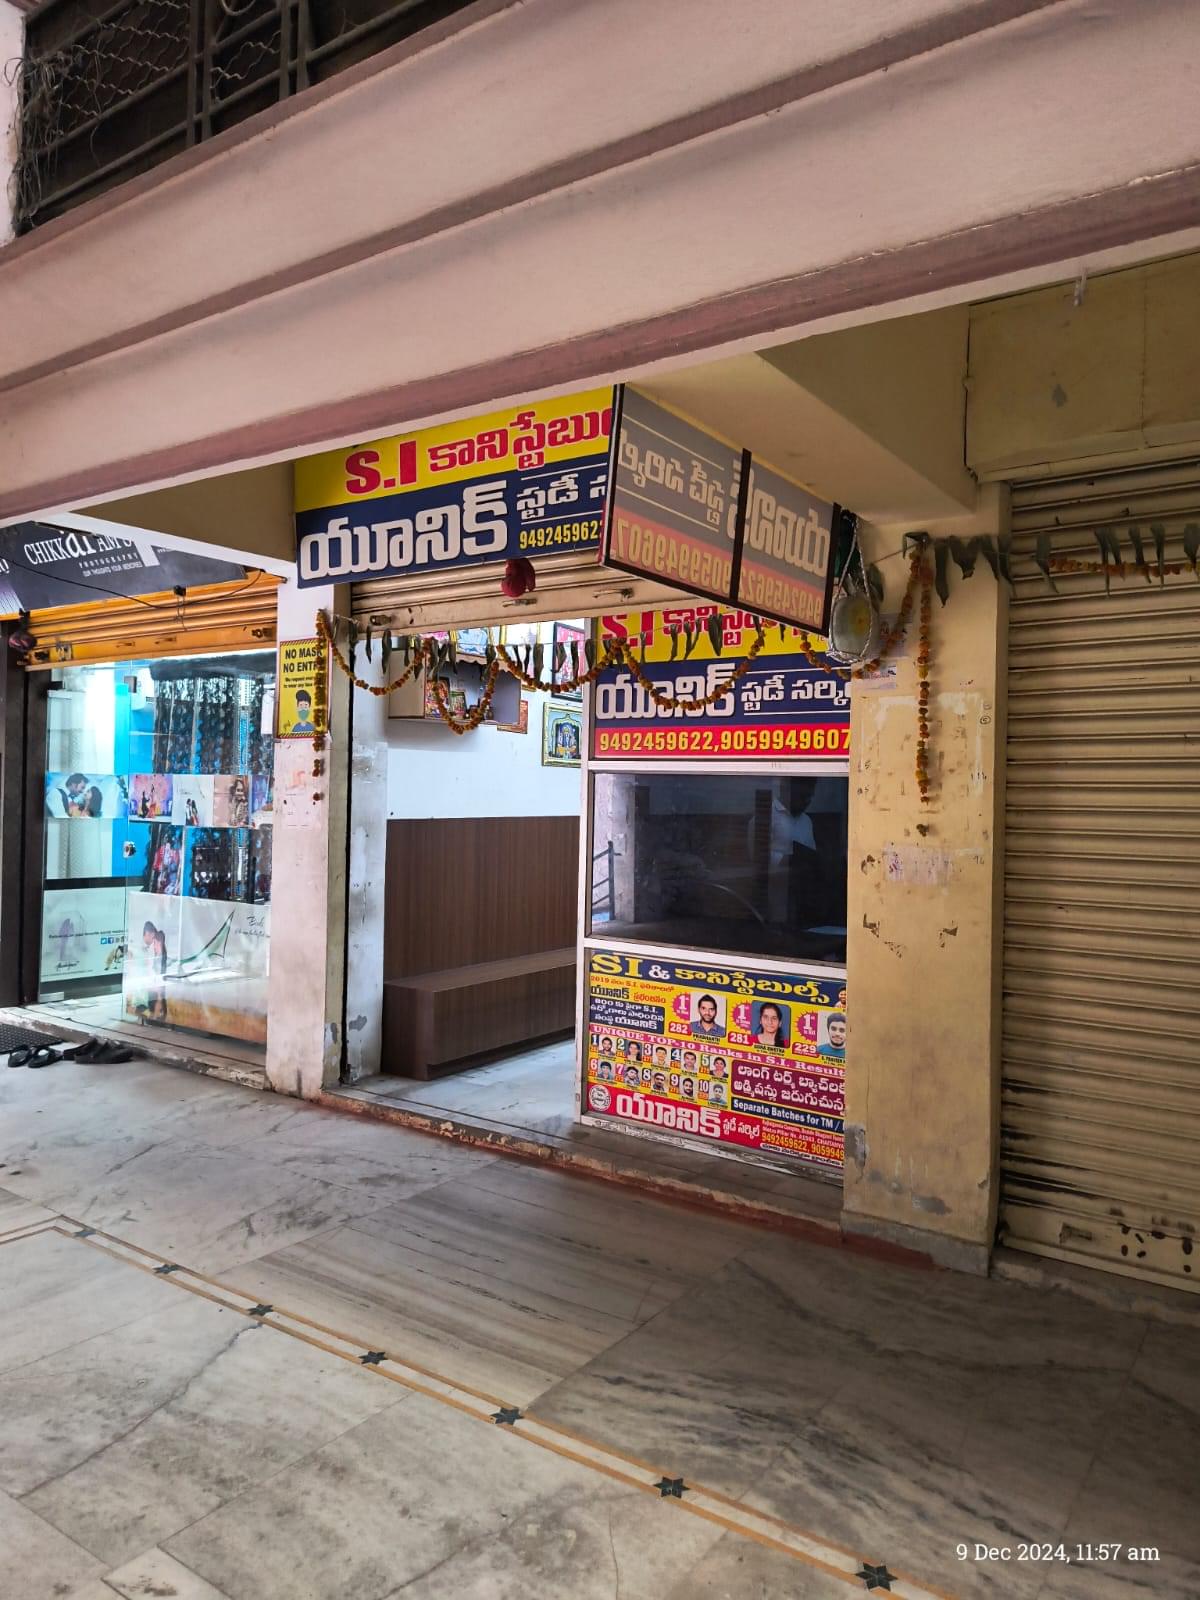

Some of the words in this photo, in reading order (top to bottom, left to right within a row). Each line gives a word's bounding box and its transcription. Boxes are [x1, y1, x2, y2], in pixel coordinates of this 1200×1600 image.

[345, 440, 417, 495] S.I
[300, 480, 508, 580] యూనిక్
[516, 472, 579, 522] స్టడీ
[519, 519, 603, 549] 949245962
[285, 649, 297, 659] NO
[283, 663, 295, 673] NO
[297, 661, 318, 673] ENT
[596, 663, 736, 720] యూనిక్
[741, 674, 785, 711] స్టడీ
[591, 954, 643, 978] SI
[648, 964, 671, 980] &
[591, 976, 609, 984] 2019
[670, 1022, 688, 1035] 282
[592, 1034, 597, 1046] 1
[618, 1038, 625, 1050] 2
[730, 1032, 750, 1045] 281
[593, 1025, 645, 1041] UNIQUE
[648, 1034, 696, 1050] TOP-10
[700, 1045, 743, 1058] Ranks
[748, 1052, 761, 1062] in
[766, 1055, 790, 1067] S.I.
[644, 1043, 651, 1056] 3
[794, 1043, 817, 1054] 229
[671, 1049, 680, 1060] 4
[702, 1054, 709, 1066] 5
[590, 1058, 597, 1071] 6
[616, 1064, 624, 1075] 7
[643, 1068, 651, 1081] 8
[738, 1065, 770, 1080] లాంగ్
[670, 1074, 678, 1086] 9
[699, 1080, 709, 1093] 10
[616, 1092, 721, 1138] యూనిక్
[734, 1099, 769, 1114] Separate
[772, 1107, 804, 1122] Batches
[807, 1114, 819, 1125] for
[821, 1116, 834, 1128] TM
